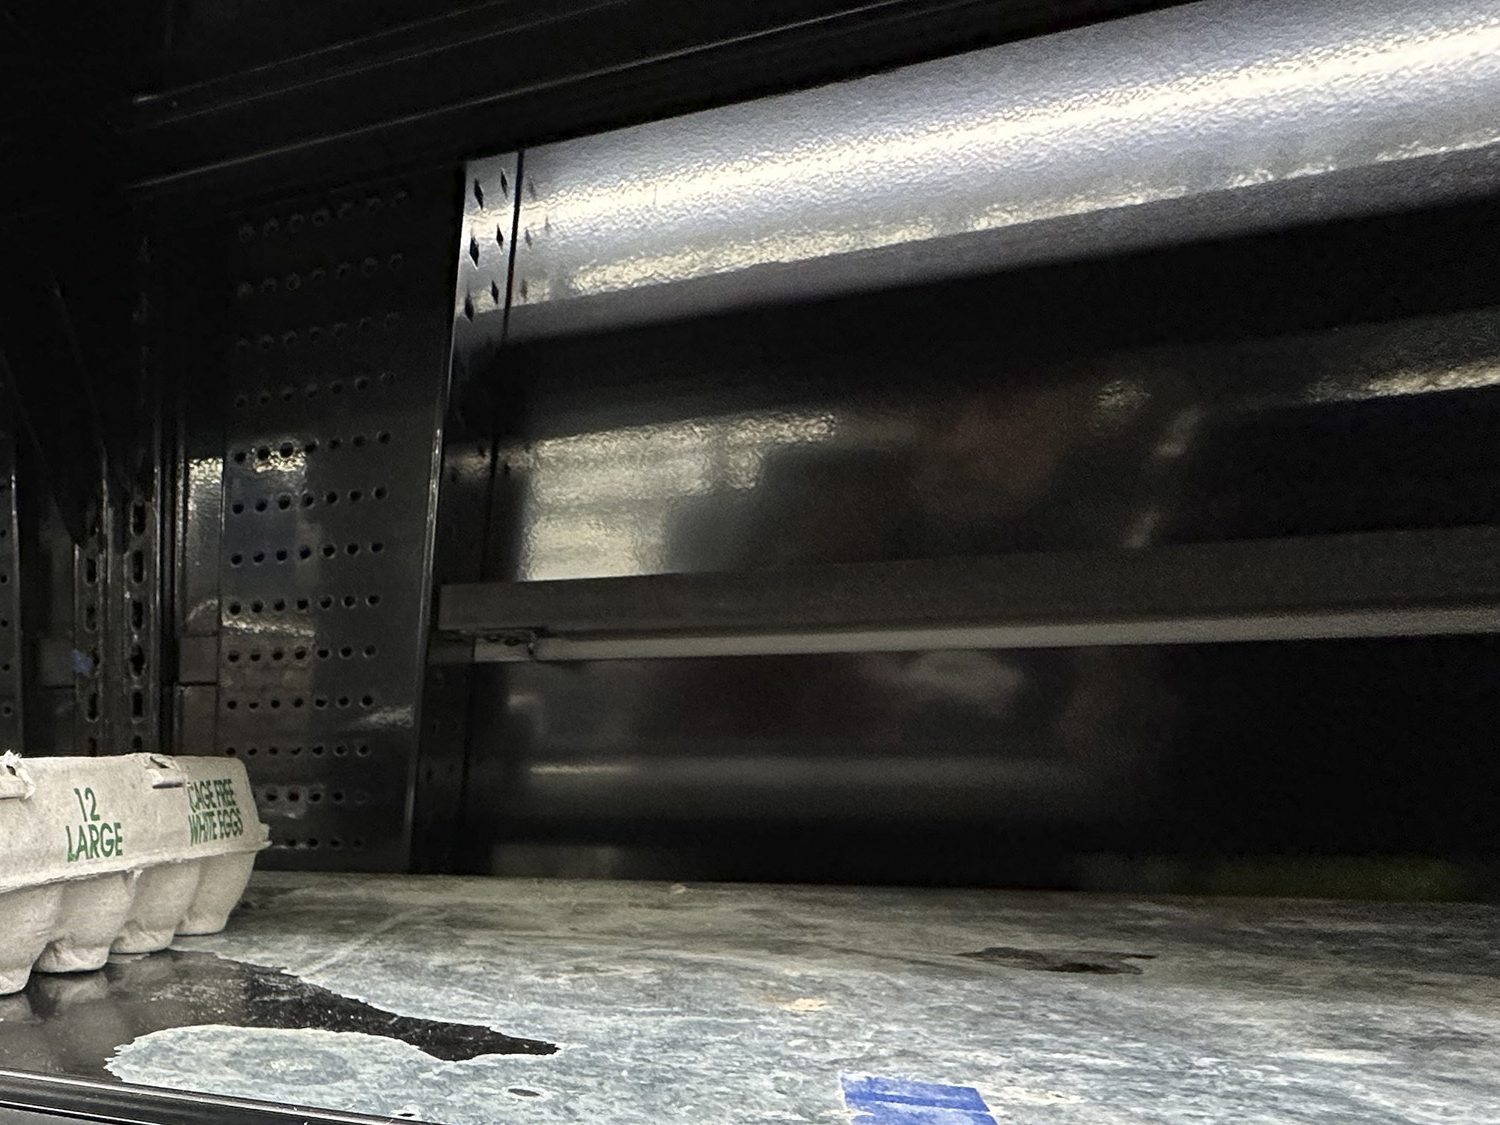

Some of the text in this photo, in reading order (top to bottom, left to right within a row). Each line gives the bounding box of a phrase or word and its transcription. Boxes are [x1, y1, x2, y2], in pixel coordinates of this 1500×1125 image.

[74, 788, 100, 822] 12
[188, 778, 236, 813] CAGE FREE
[66, 823, 123, 863] LARGE
[188, 808, 243, 846] WHITE EGGS
